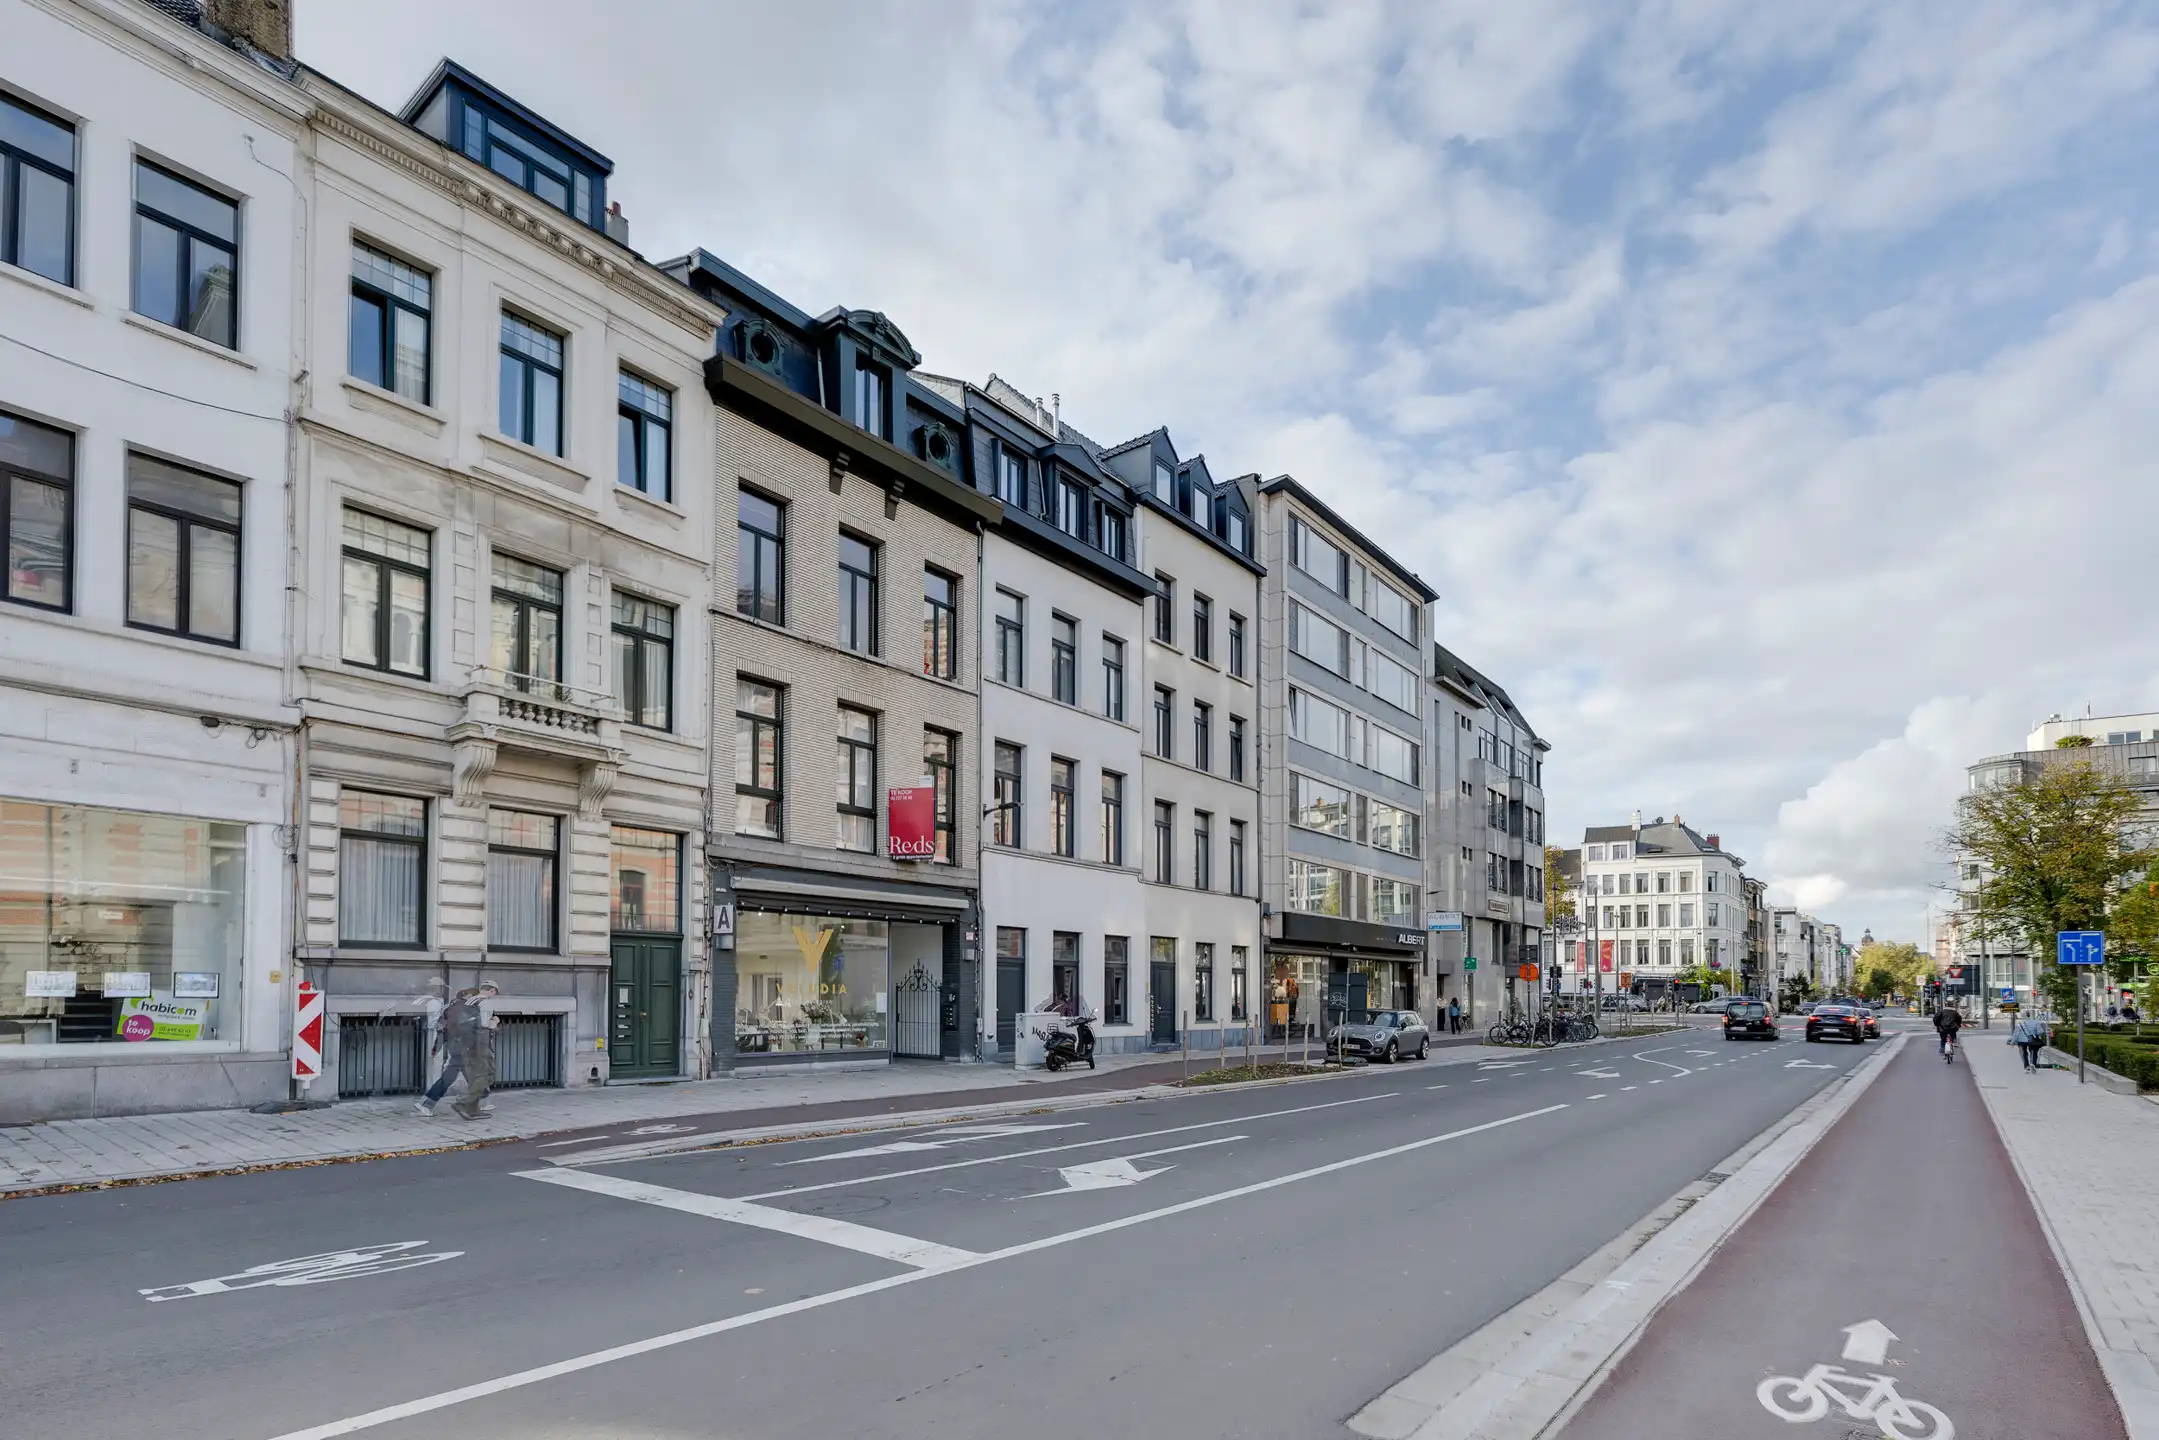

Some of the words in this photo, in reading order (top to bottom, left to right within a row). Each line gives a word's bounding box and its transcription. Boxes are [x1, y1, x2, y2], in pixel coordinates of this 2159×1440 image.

[889, 835, 934, 854] Reds
[718, 906, 731, 929] A
[1398, 933, 1425, 946] ALBERT
[141, 1001, 197, 1016] habicom
[126, 1025, 151, 1036] koop
